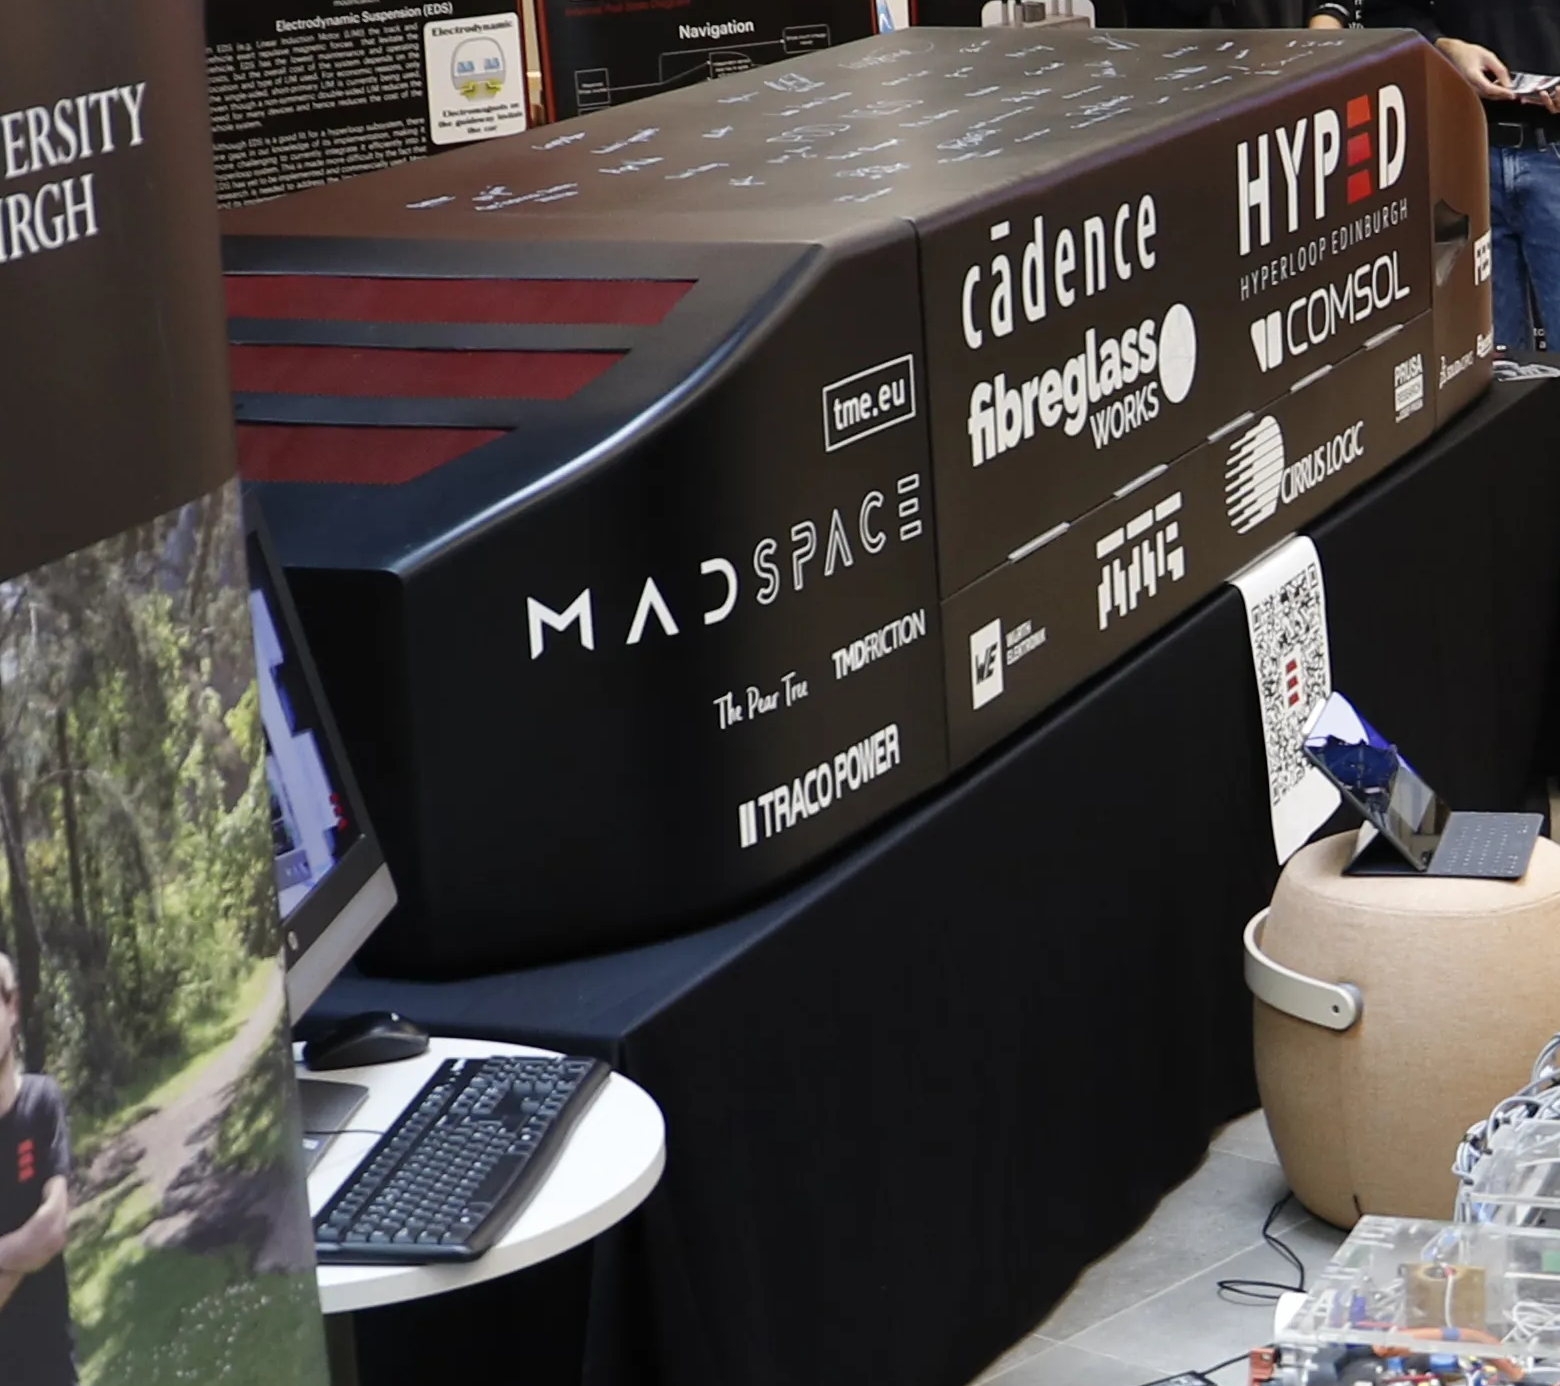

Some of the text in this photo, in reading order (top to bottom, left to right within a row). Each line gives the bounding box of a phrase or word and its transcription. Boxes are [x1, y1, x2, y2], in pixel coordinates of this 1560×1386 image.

[275, 0, 454, 32] Electrodynamic Suspension (EDS)
[678, 17, 755, 41] Navigation
[1236, 83, 1407, 257] HYPED
[1239, 197, 1409, 302] HYPERLOOP EDINBURGH
[1286, 249, 1411, 356] COMSOL
[831, 372, 907, 432] tme.eu
[967, 313, 1159, 468] fibreglass
[1393, 353, 1424, 386] PRUSA
[1089, 380, 1160, 450] WORKS
[1280, 420, 1364, 506] CIRRUS LOGIC
[712, 670, 810, 731] The Pear Tree
[758, 721, 902, 840] TRACO POWER
